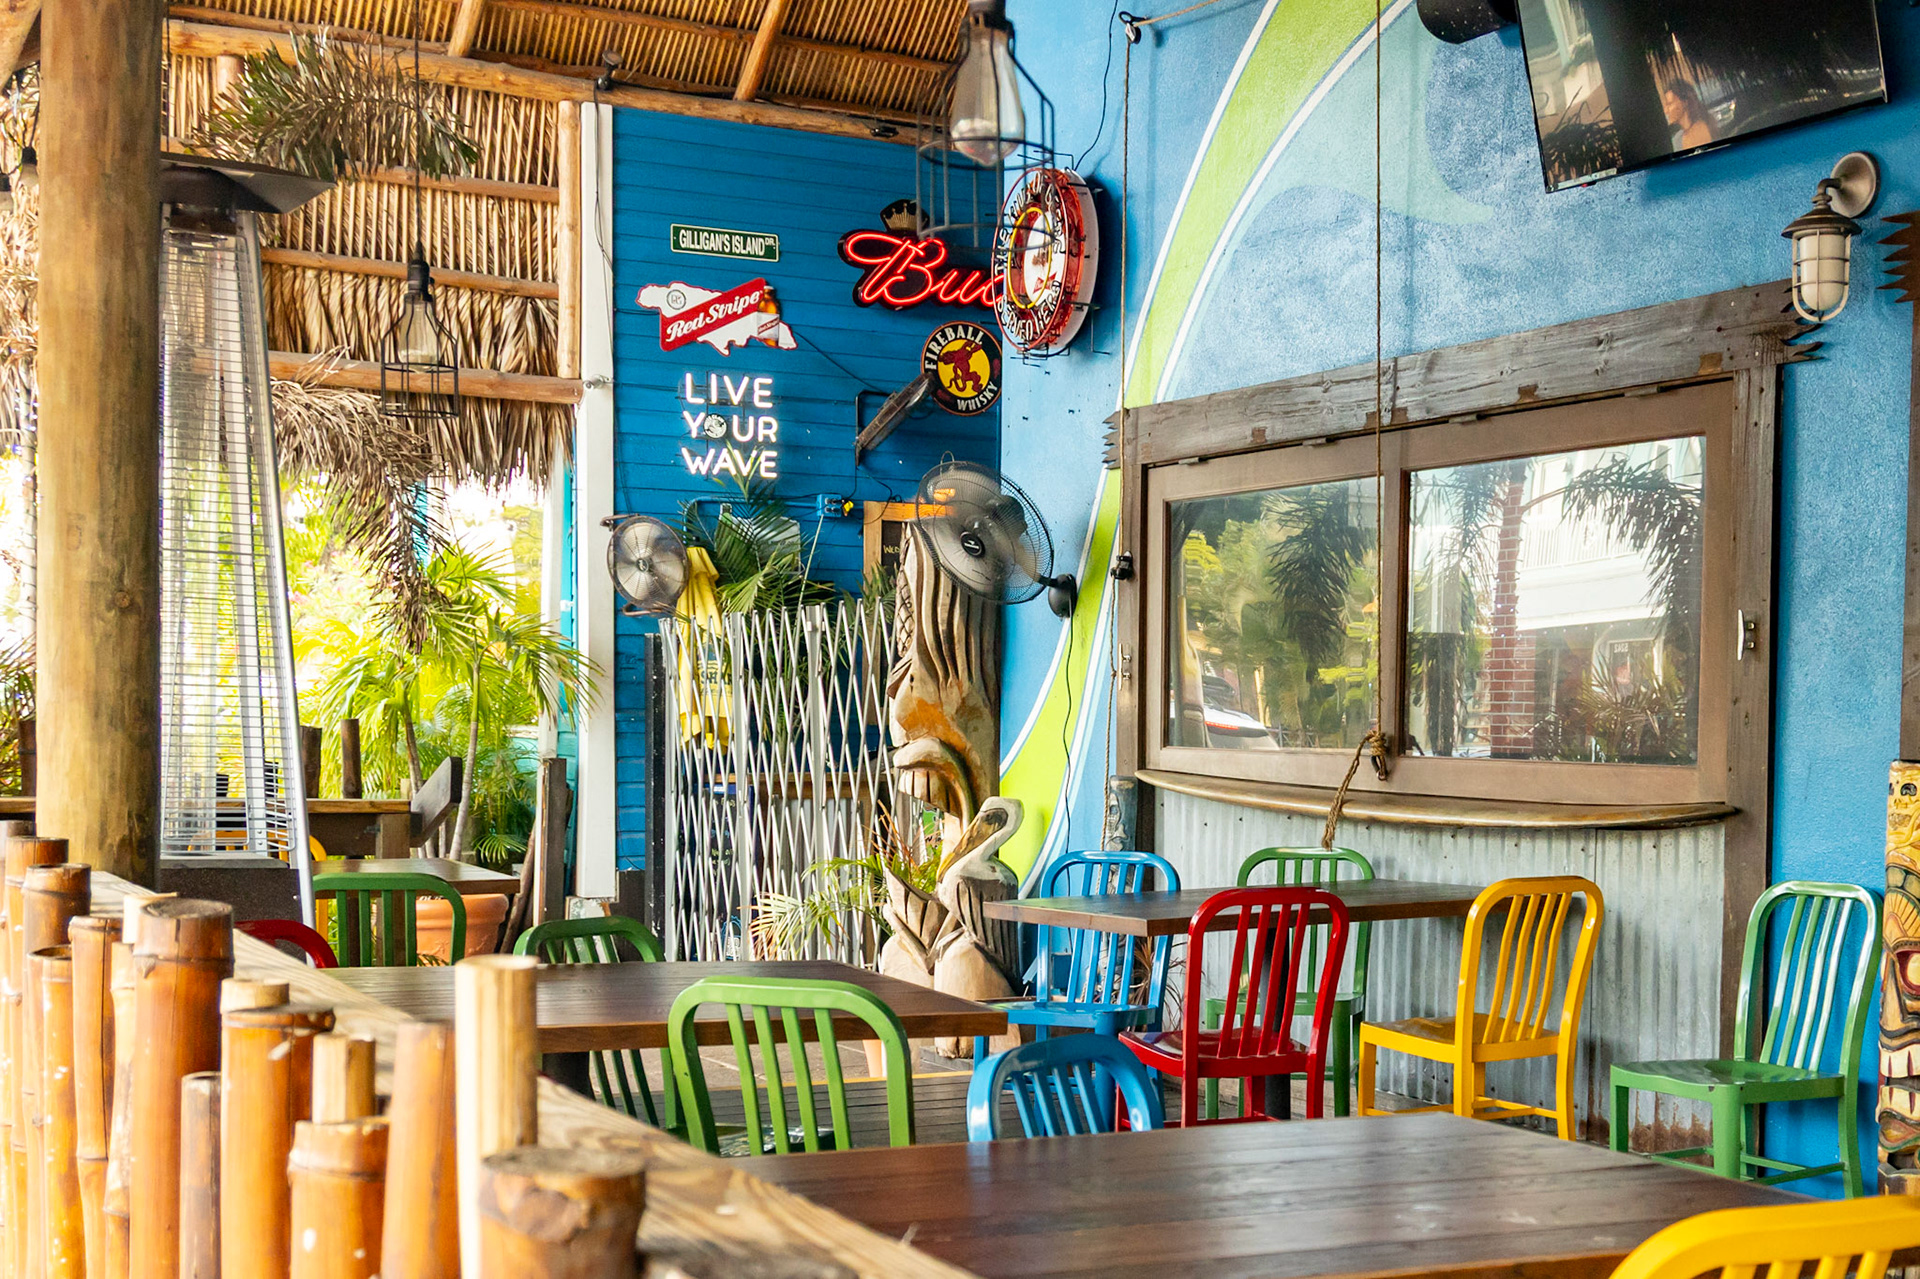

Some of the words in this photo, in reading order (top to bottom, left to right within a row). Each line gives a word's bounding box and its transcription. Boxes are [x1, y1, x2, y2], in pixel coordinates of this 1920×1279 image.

[679, 229, 731, 253] GILLIGAN'S
[731, 235, 765, 256] ISLAND
[665, 313, 706, 343] Red
[705, 290, 760, 323] Stripe
[924, 325, 985, 370] FIREBALL
[685, 372, 773, 408] LIVE
[956, 381, 998, 411] WHISKY
[681, 447, 778, 478] WAVE
